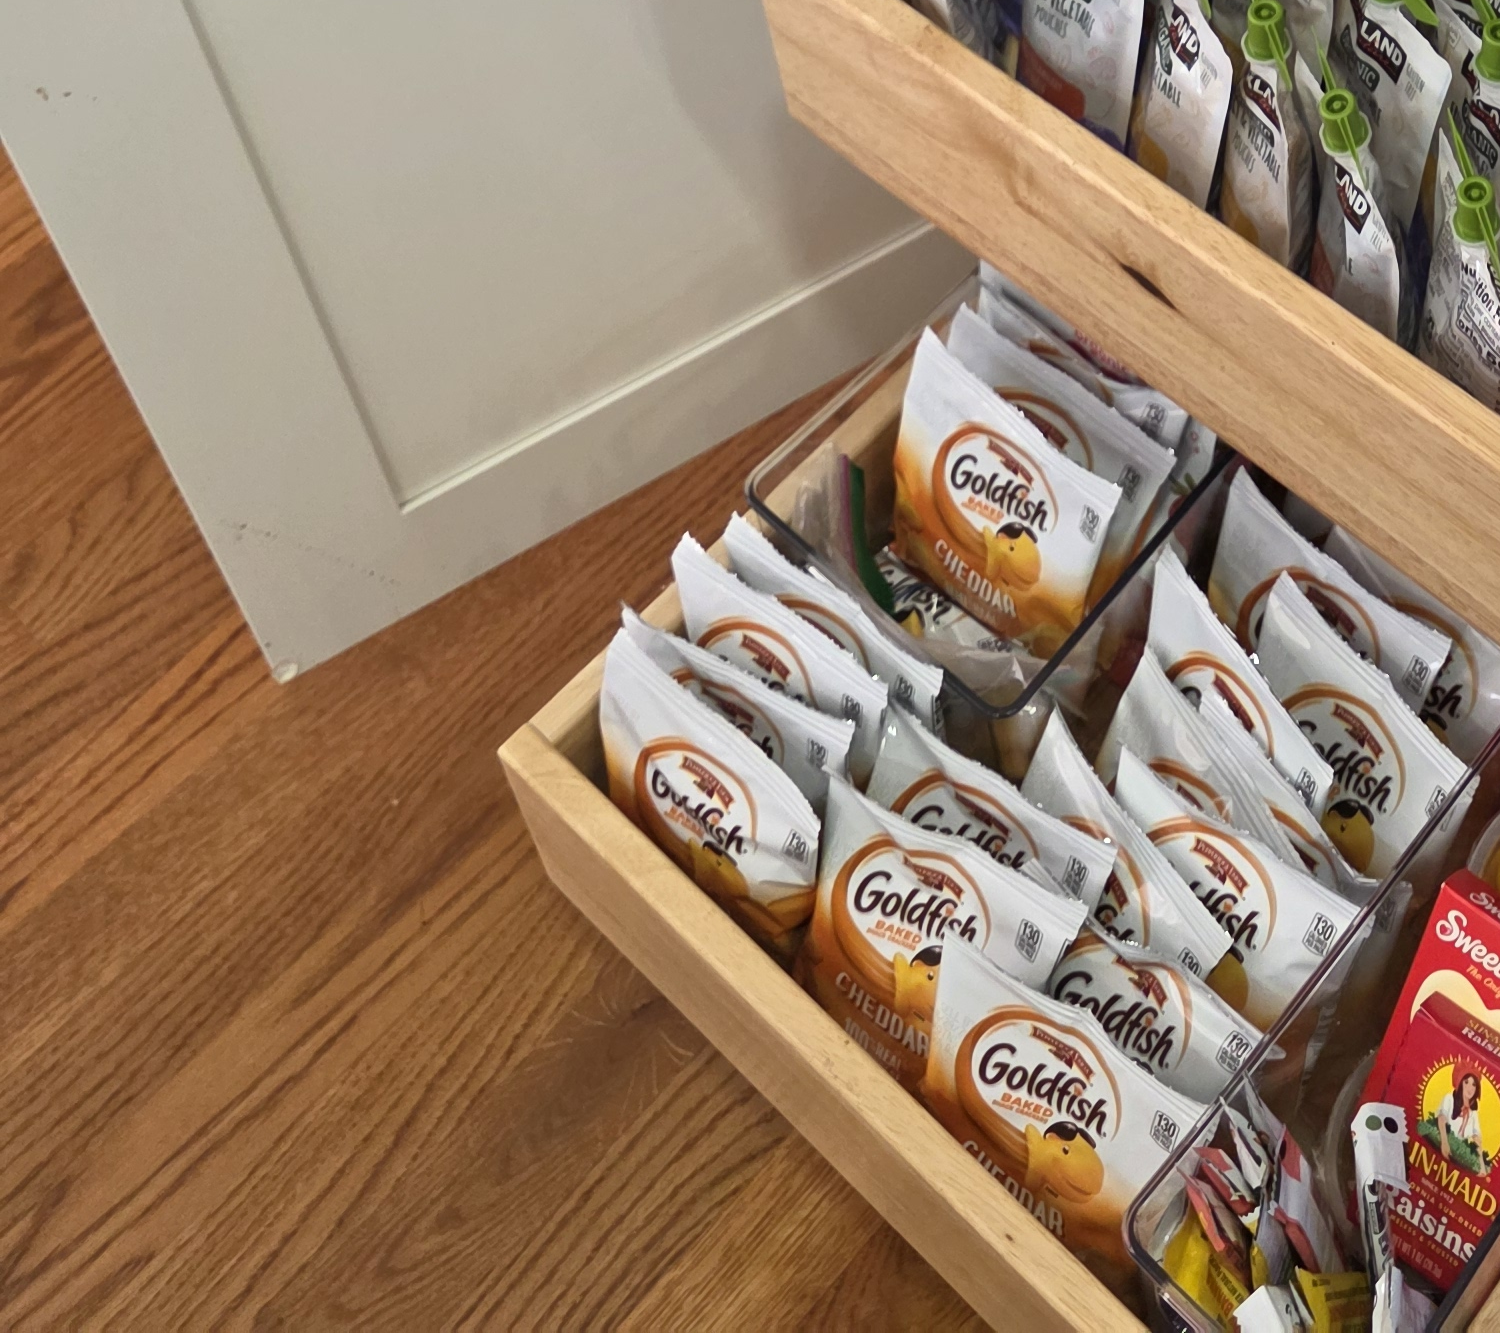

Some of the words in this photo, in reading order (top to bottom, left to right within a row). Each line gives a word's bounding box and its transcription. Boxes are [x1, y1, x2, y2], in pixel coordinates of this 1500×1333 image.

[950, 452, 1048, 533] Goldfish
[935, 537, 1017, 618] CHEDDAR
[1411, 657, 1430, 679] 130
[1299, 770, 1316, 791] 130
[853, 869, 978, 943] Goldfish
[874, 919, 923, 945] BAKED
[1022, 921, 1040, 944] 130
[1314, 914, 1335, 937] 130
[1466, 964, 1483, 982] The
[836, 970, 930, 1057] CHEDDAR
[1053, 970, 1176, 1070] Goldfish
[1226, 1032, 1249, 1054] 130
[978, 1042, 1108, 1137] Goldfish
[999, 1092, 1054, 1119] BAKED
[1156, 1113, 1177, 1134] 130
[1385, 1184, 1477, 1264] Raisins
